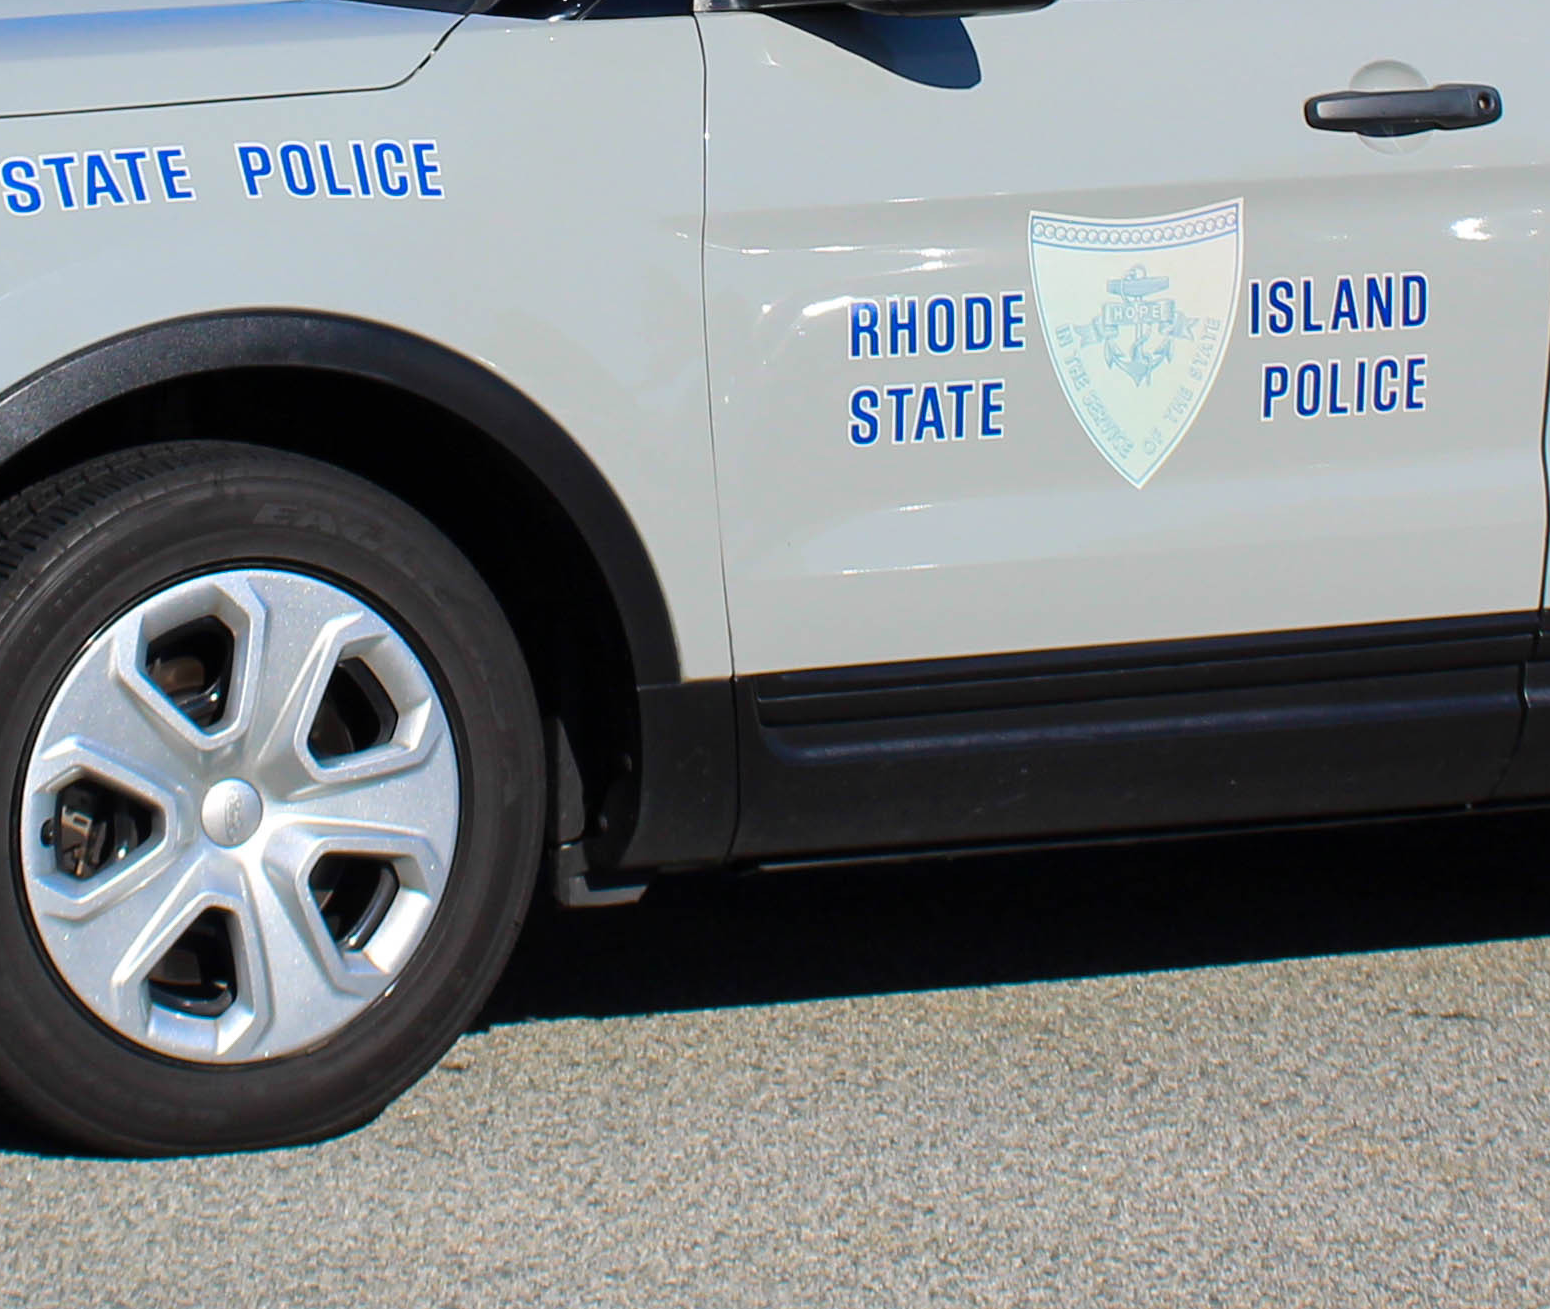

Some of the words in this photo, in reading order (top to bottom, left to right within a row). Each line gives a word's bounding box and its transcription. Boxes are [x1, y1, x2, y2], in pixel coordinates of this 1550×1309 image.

[234, 138, 445, 200] POLICE
[848, 292, 1025, 360] RHODE
[1248, 271, 1429, 337] ISLAND
[1112, 304, 1163, 320] HOPE
[848, 379, 1005, 448] STATE
[1260, 354, 1427, 420] POLICE
[1064, 354, 1090, 391] THE
[1163, 386, 1194, 423] THE
[1190, 316, 1222, 381] STATE
